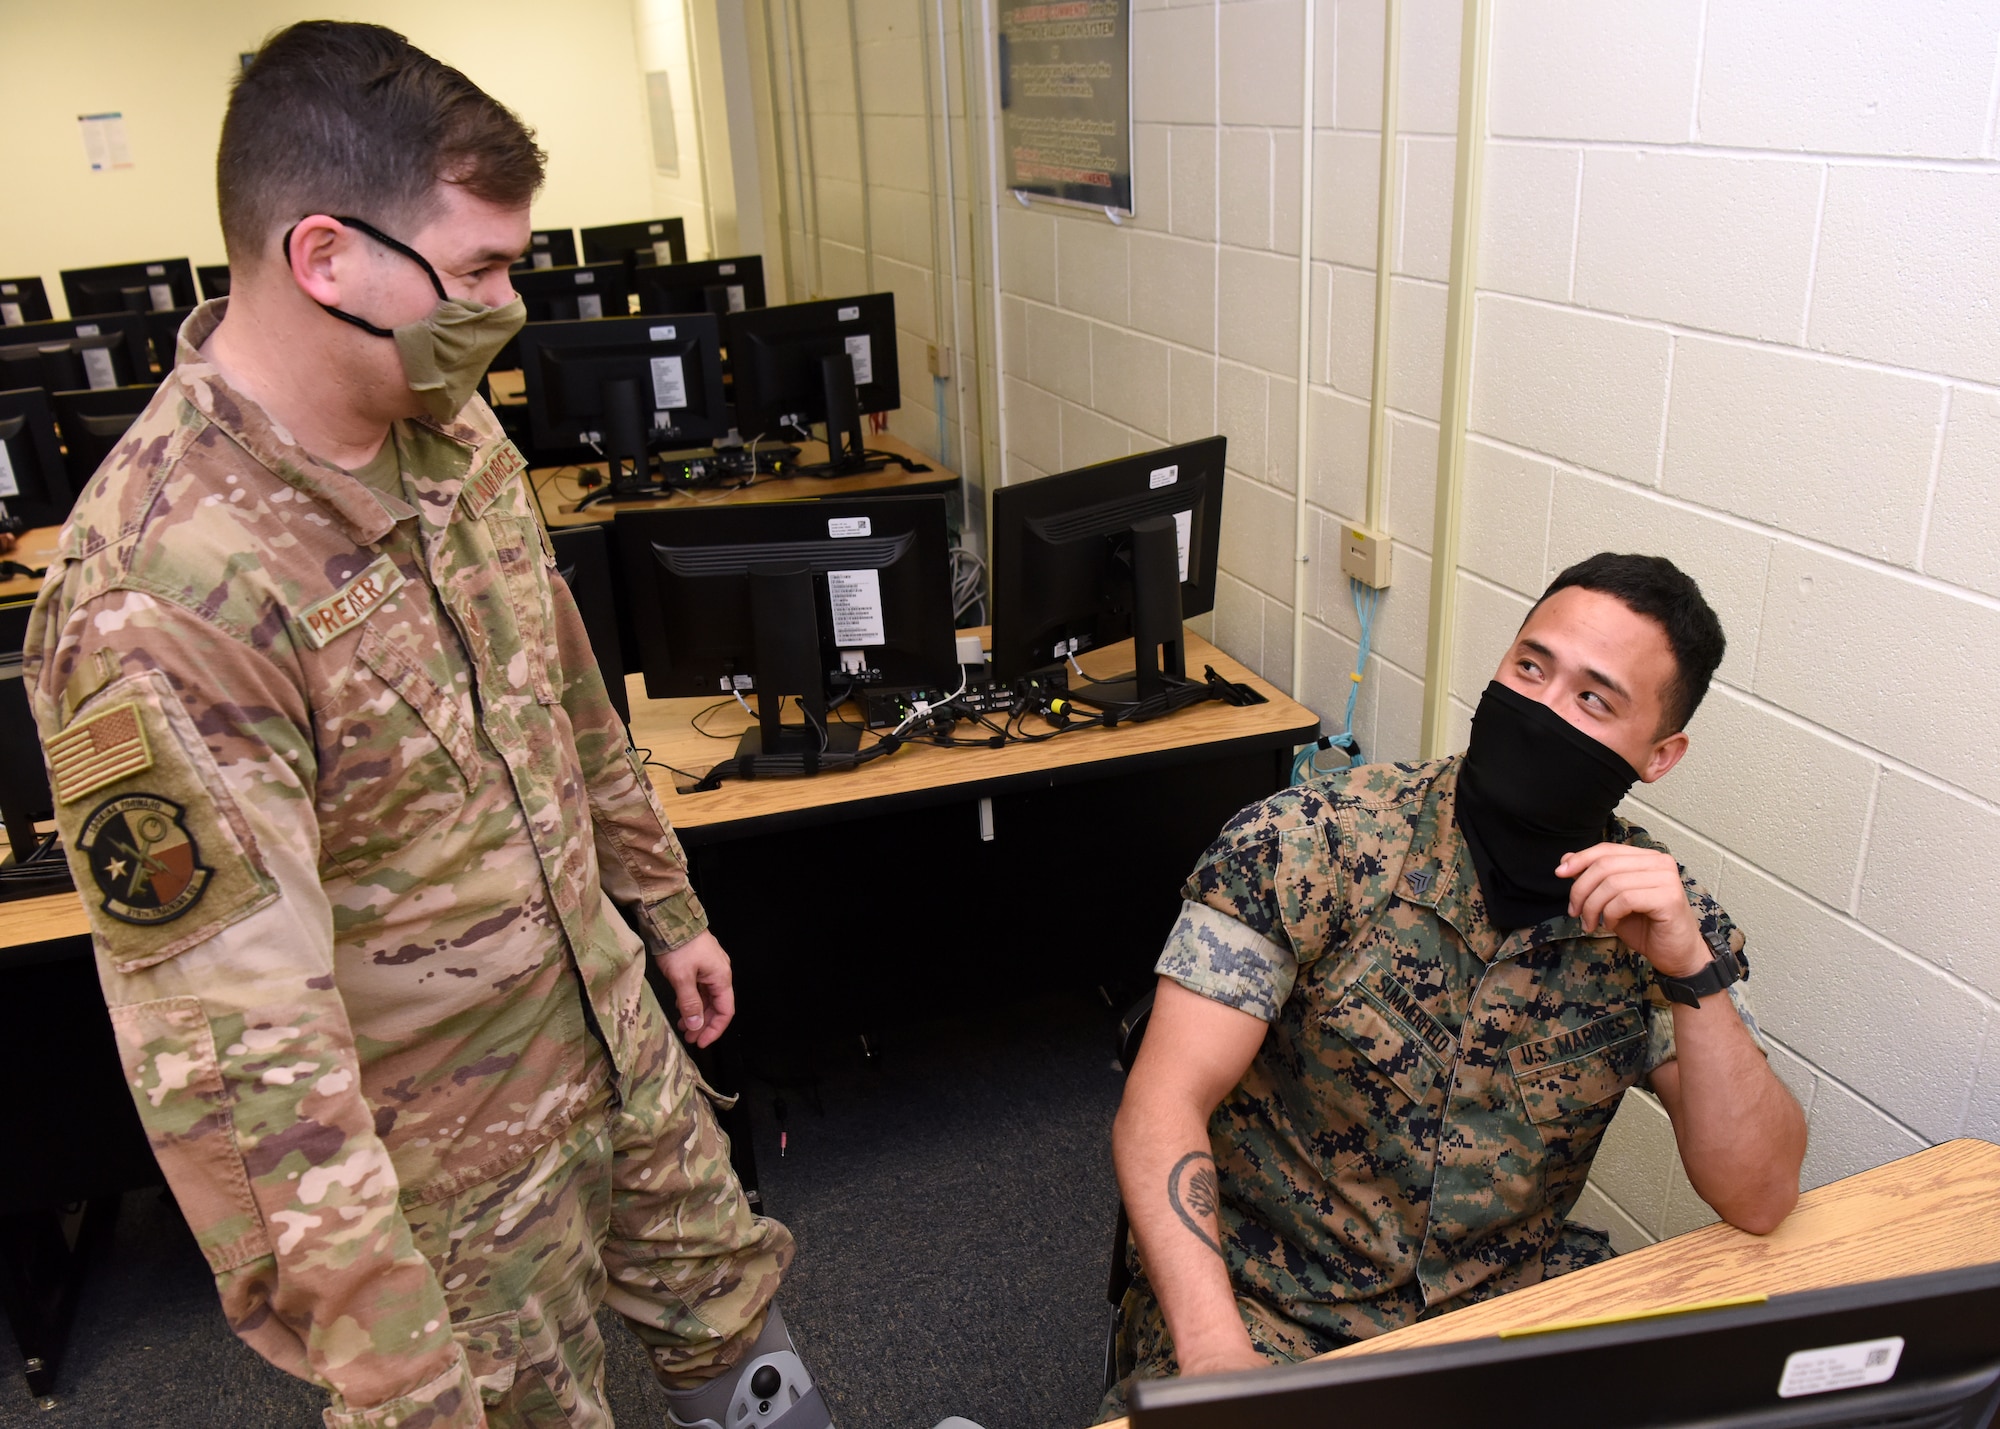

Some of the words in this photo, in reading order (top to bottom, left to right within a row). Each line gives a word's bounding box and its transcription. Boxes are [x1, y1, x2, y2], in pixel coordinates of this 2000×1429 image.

[1084, 20, 1114, 37] SYSTEM
[1376, 974, 1450, 1053] SUMMERFIELD
[1520, 1041, 1552, 1066] U.S.
[1554, 1015, 1629, 1058] MARINES
